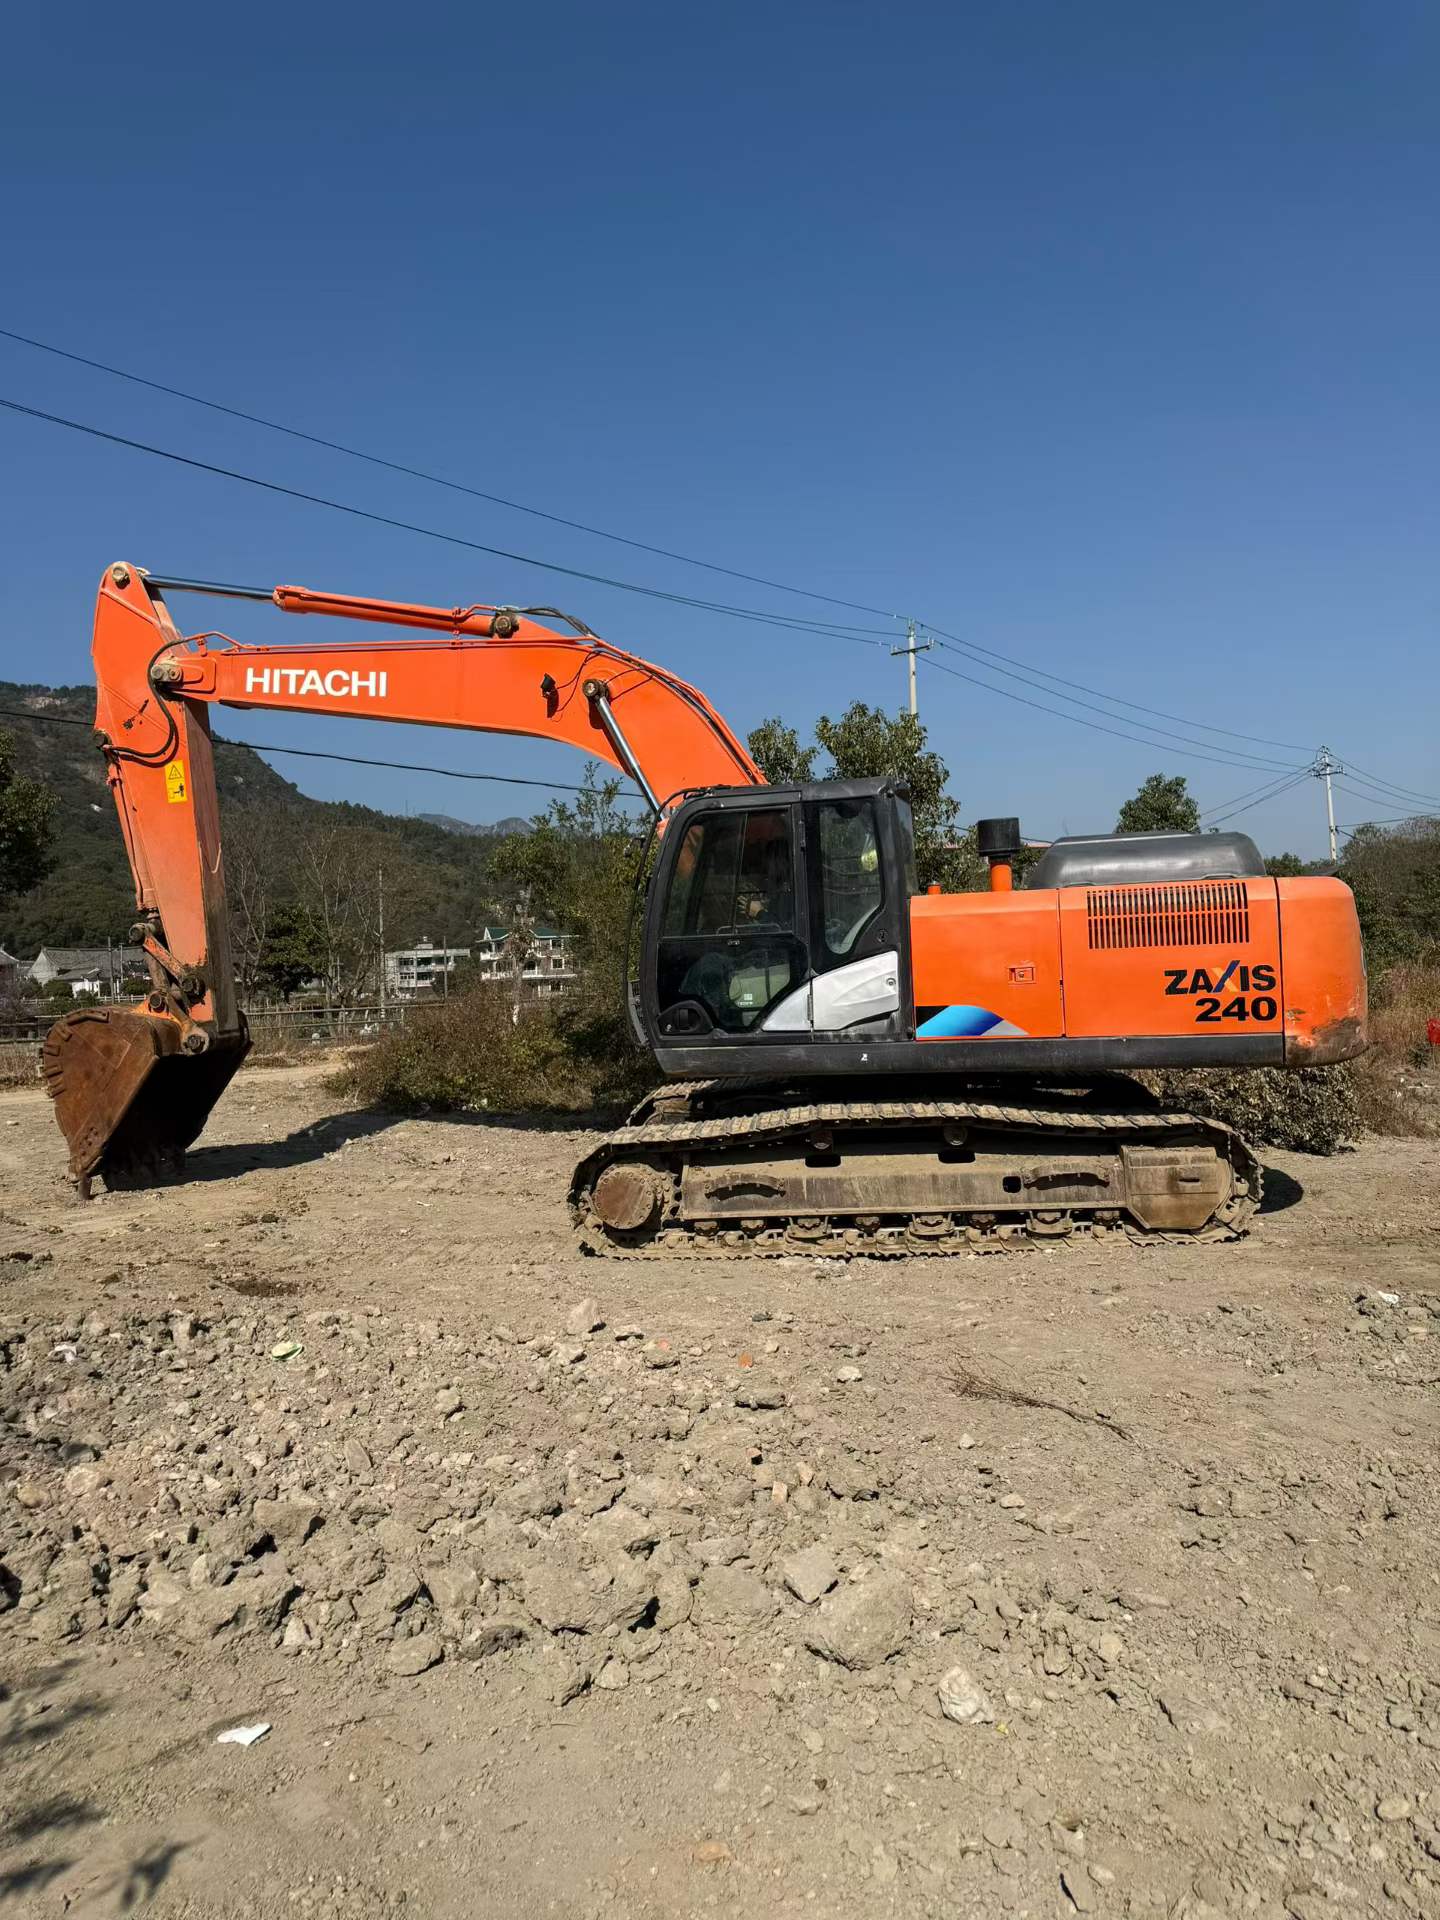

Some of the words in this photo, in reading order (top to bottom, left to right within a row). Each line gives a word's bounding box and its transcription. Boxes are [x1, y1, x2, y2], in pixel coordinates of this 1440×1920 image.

[245, 667, 387, 697] HITACHI
[1164, 960, 1276, 995] ZAXIS
[1195, 996, 1277, 1022] 240
